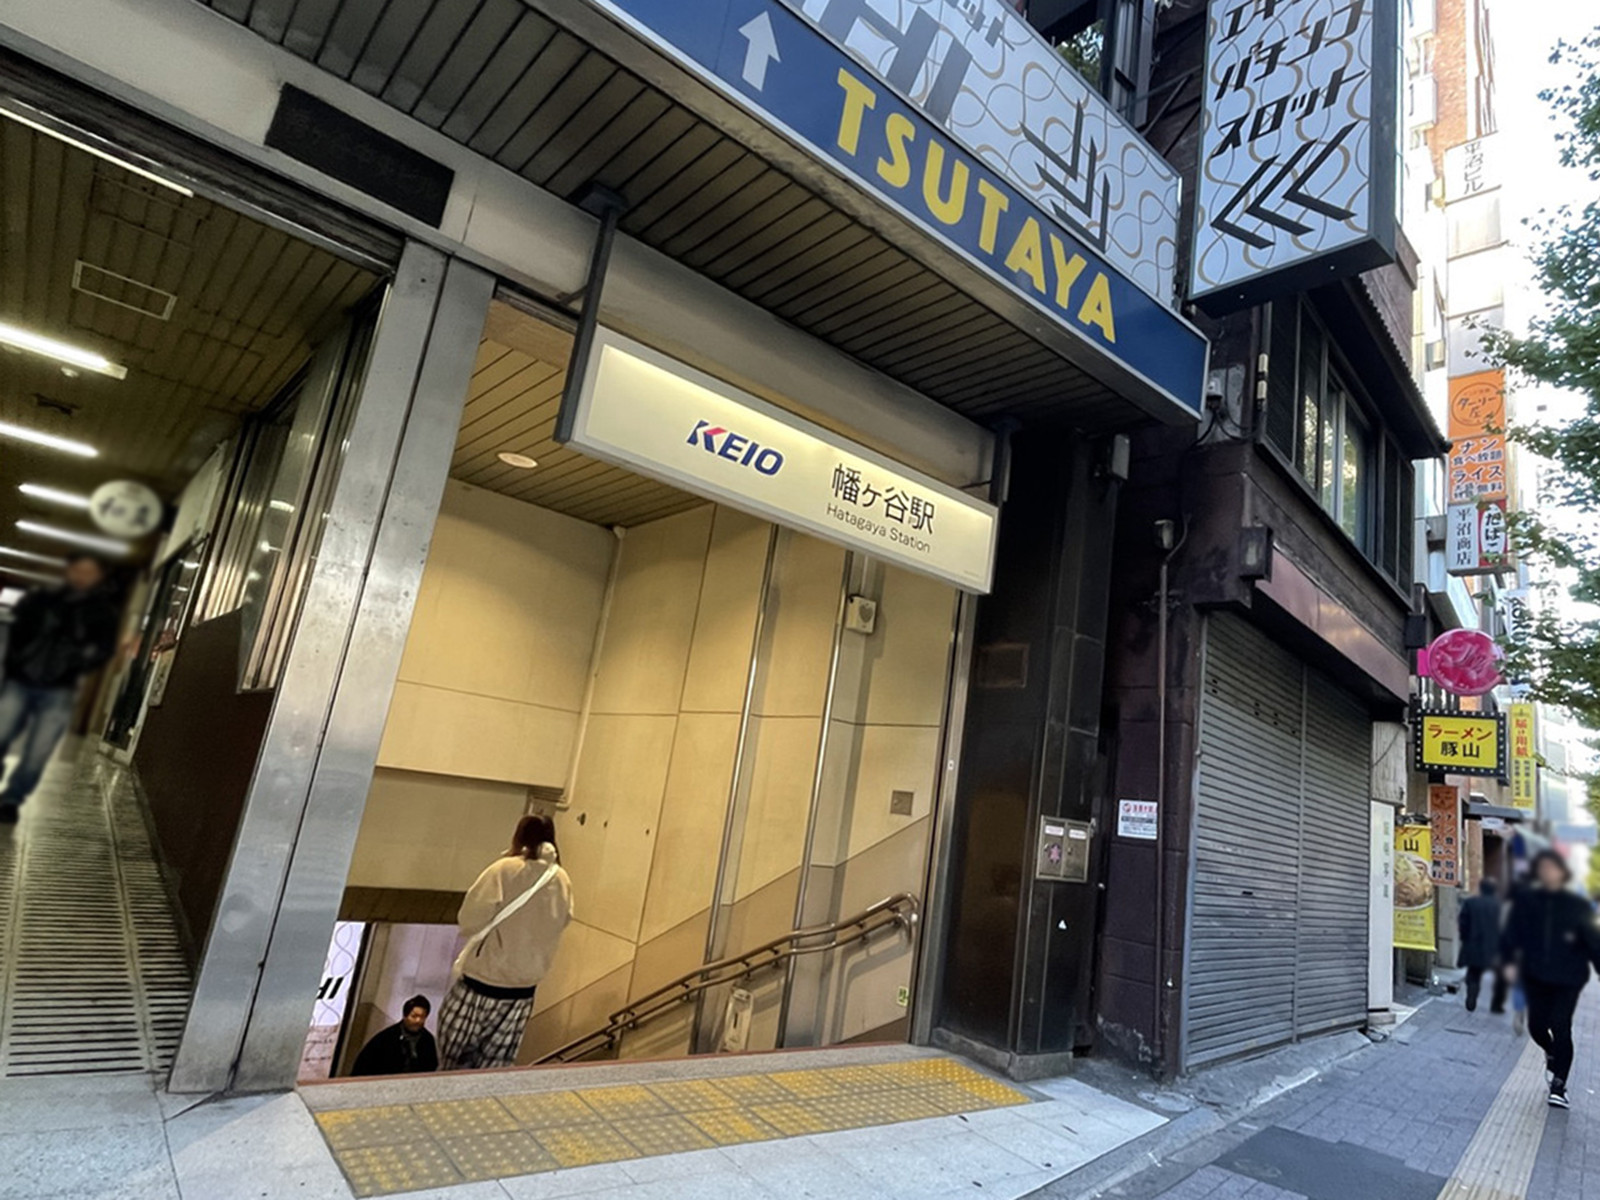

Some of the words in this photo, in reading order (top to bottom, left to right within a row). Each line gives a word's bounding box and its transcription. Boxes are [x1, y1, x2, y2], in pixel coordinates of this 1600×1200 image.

[1215, 0, 1365, 102] パチンコ
[1210, 67, 1367, 159] スロット
[837, 67, 1117, 343] TSUTAYA
[686, 419, 784, 477] KEIO
[1453, 465, 1503, 483] ライス
[827, 502, 887, 537] Hatagaya
[890, 528, 931, 553] Station
[1428, 723, 1493, 742] ラーメン
[1440, 741, 1480, 758] 豚山
